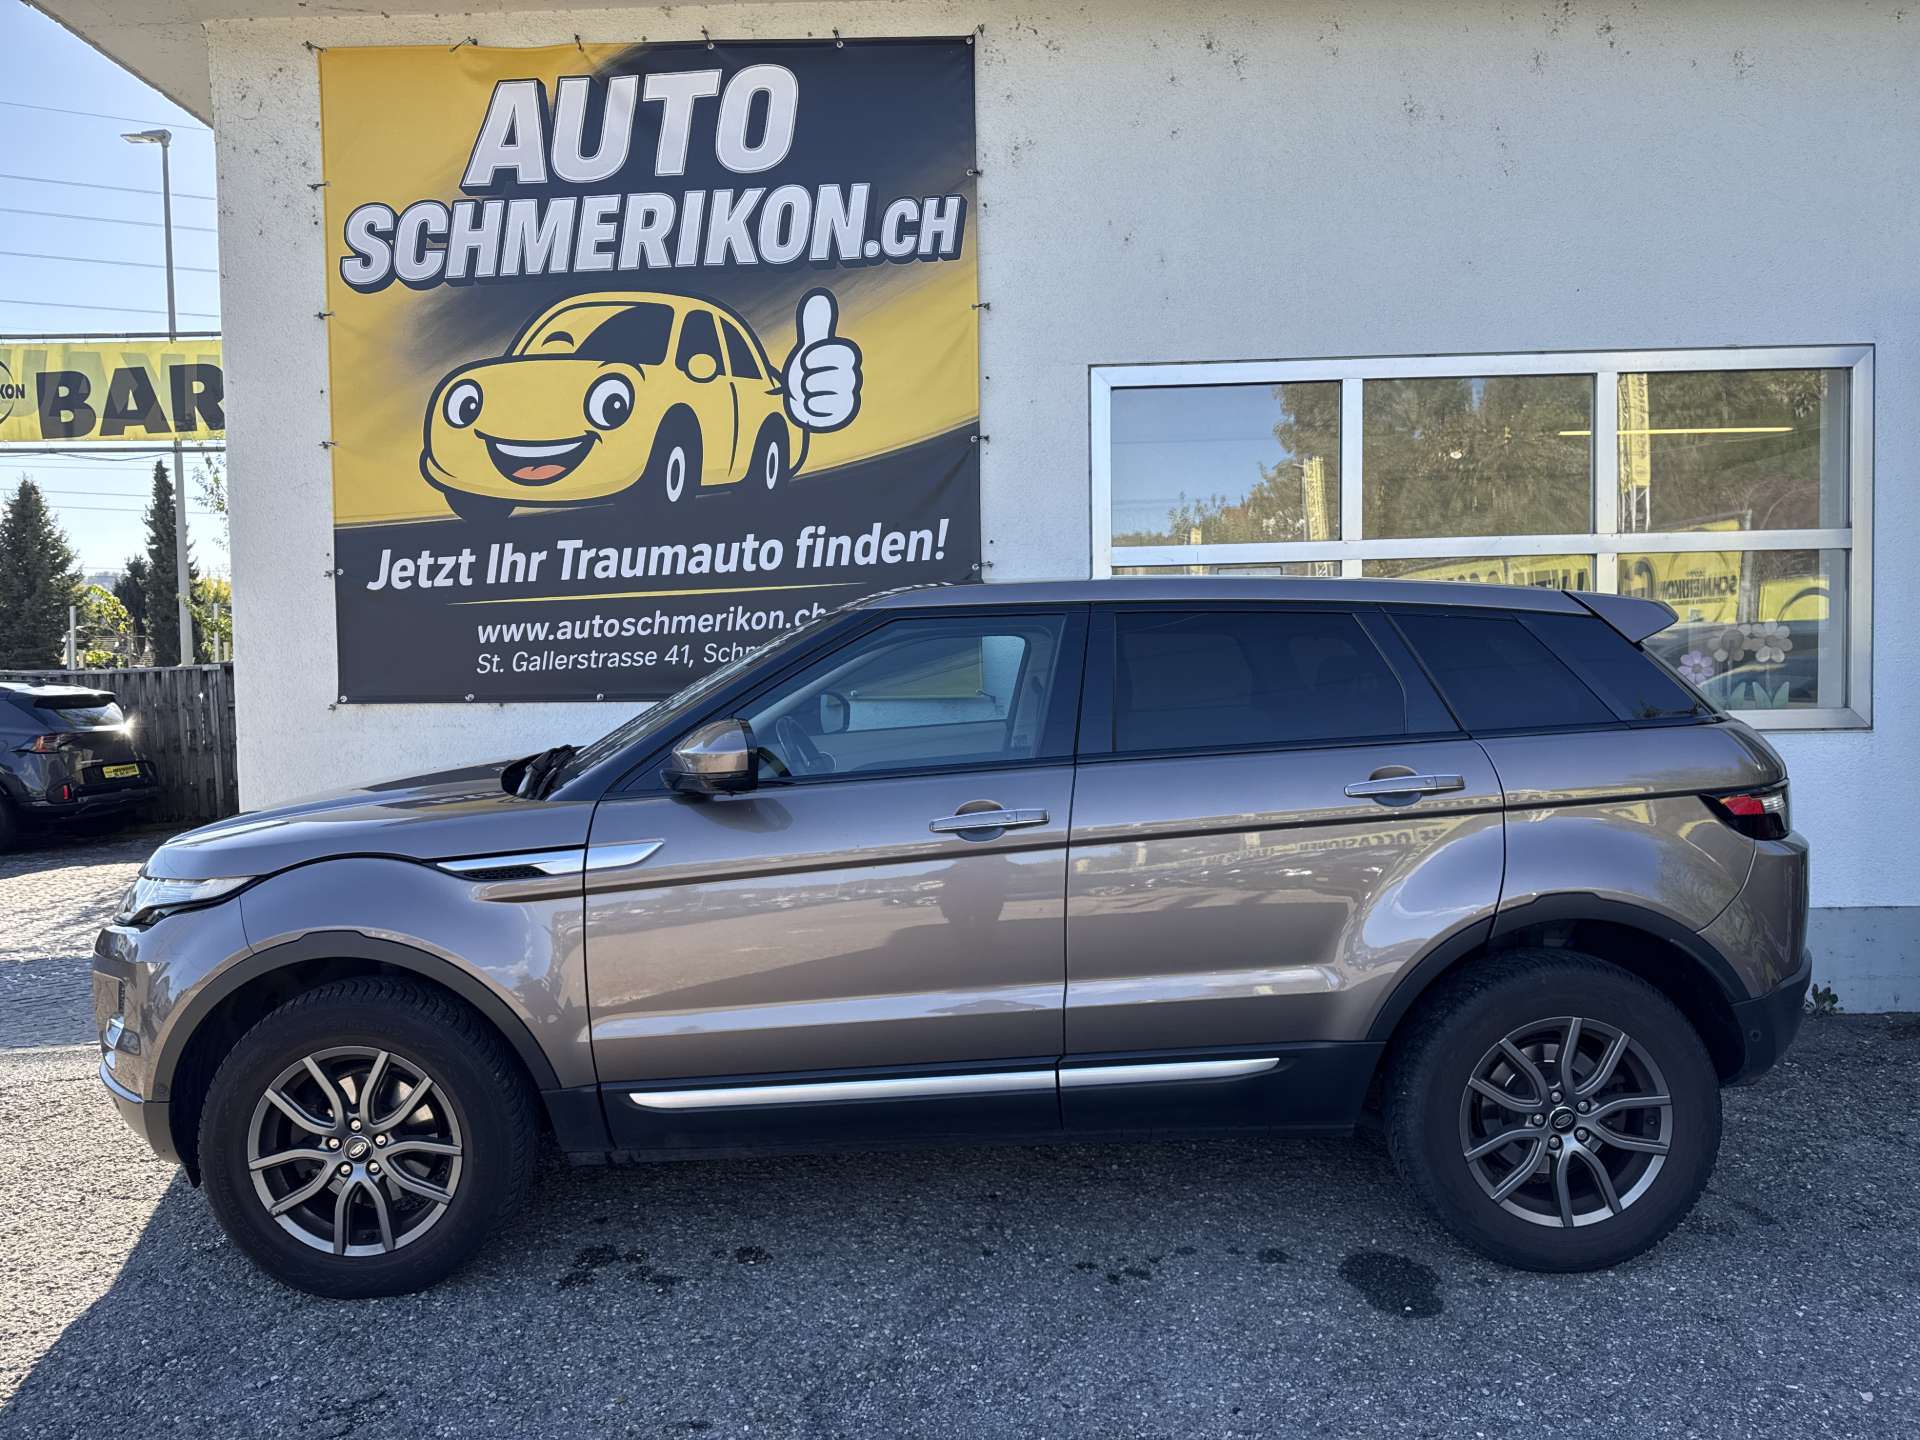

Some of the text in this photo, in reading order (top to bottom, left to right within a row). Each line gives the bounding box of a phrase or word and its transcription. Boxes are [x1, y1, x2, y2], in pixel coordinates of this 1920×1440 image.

[462, 63, 800, 190] AUTO
[341, 183, 963, 289] SCHMERIKON.CH
[35, 363, 225, 440] BAR
[366, 518, 951, 592] Jetzt Ihr Traumauto finden!
[476, 653, 505, 675] St.
[512, 647, 658, 674] Gallerstrasse
[664, 644, 694, 669] 41,
[477, 602, 827, 644] www.autoschmerikon.ch
